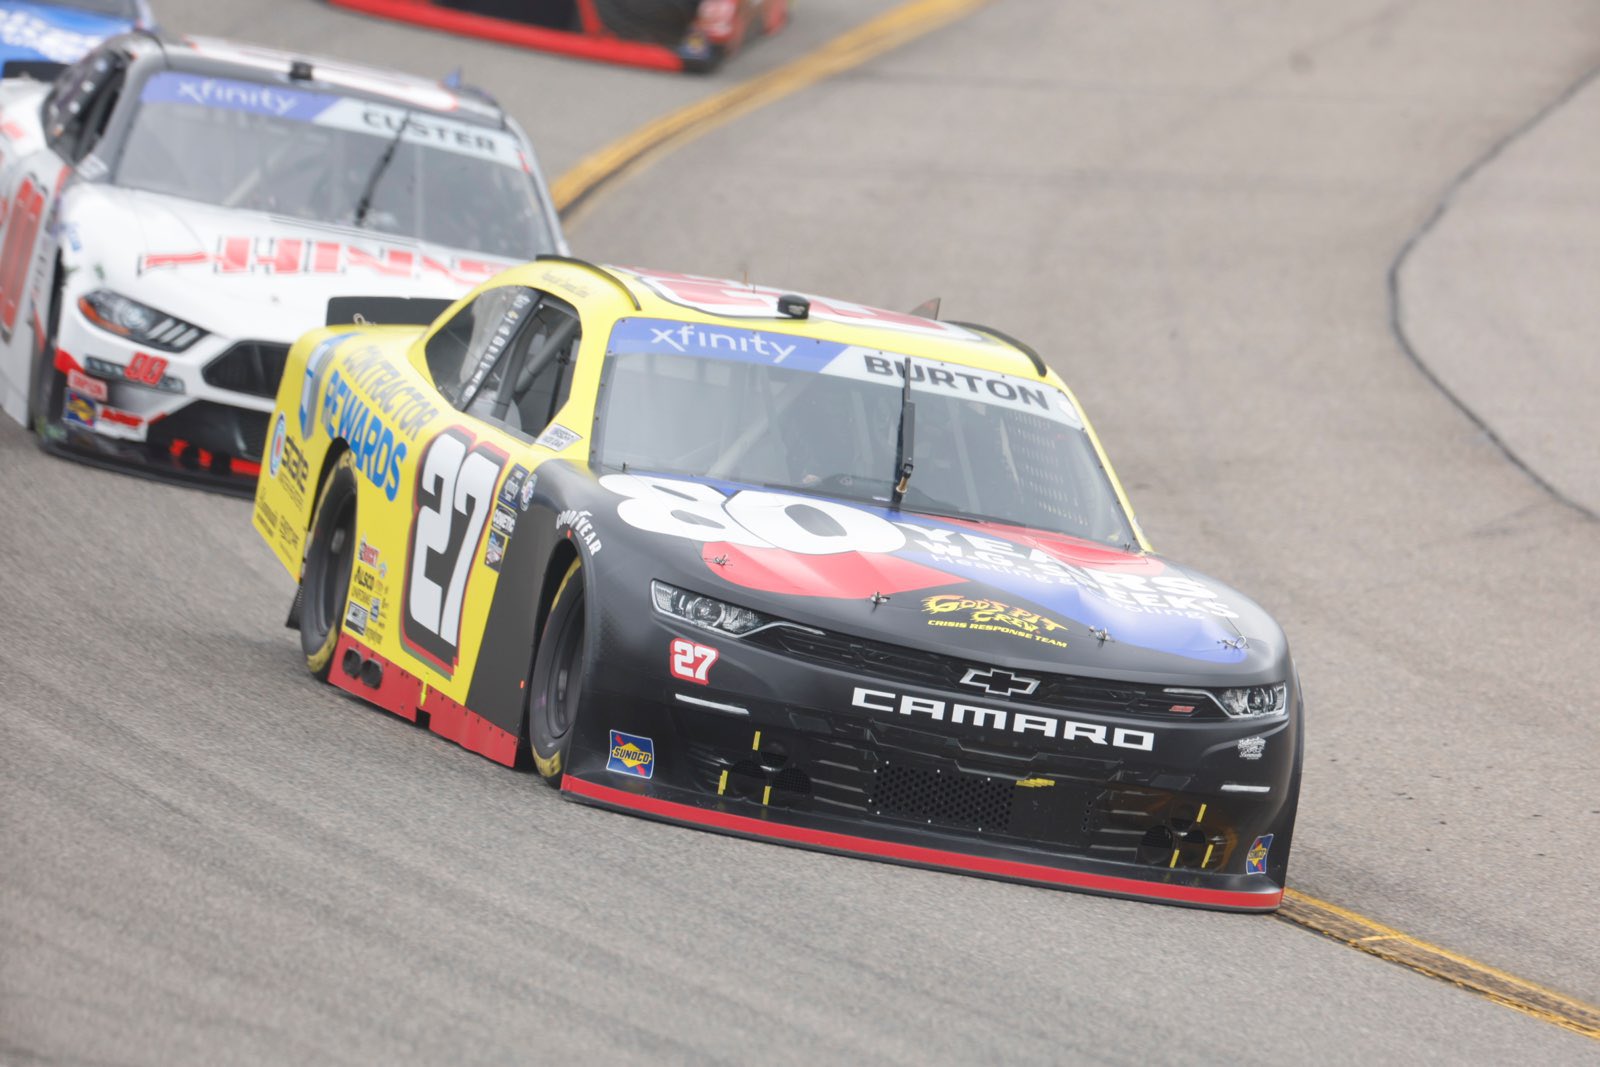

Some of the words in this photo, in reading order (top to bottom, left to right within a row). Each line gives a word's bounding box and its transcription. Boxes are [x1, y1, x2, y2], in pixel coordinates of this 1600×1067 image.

[176, 79, 300, 116] xfinity
[362, 108, 497, 156] CUSTER
[650, 324, 797, 362] xfinity
[863, 354, 1050, 411] BURTON
[320, 369, 408, 503] REWARDS
[407, 432, 501, 648] 27
[555, 508, 603, 557] GOODYEAR
[598, 473, 907, 555] 80
[893, 521, 1219, 599] YEARS
[920, 594, 1015, 616] GOD'S
[1007, 605, 1070, 632] PIT
[927, 619, 968, 630] CRISIS
[968, 622, 1034, 640] RESPONSE
[1035, 634, 1069, 649] TEAM
[969, 611, 1040, 633] CREW
[672, 639, 719, 683] 27
[852, 686, 1155, 752] CAMARO
[611, 746, 652, 765] SUNOCO
